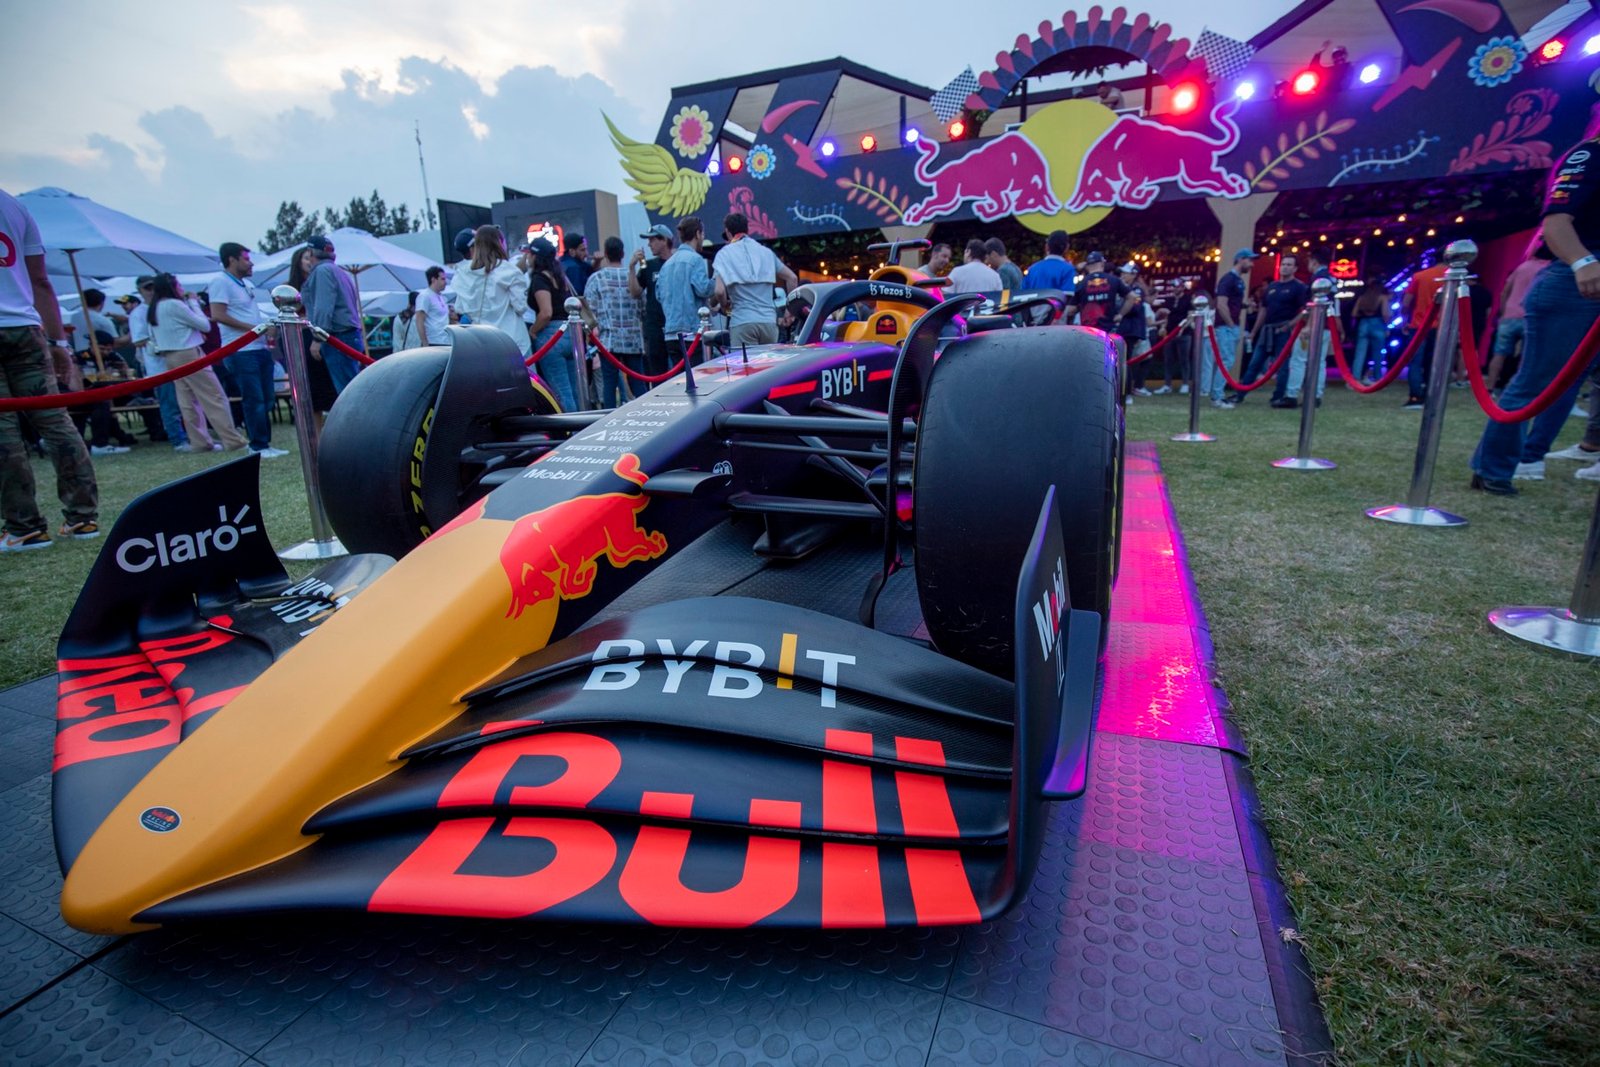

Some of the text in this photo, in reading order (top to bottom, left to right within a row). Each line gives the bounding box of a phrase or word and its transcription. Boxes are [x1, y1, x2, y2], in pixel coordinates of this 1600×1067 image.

[880, 285, 904, 296] Tezos
[821, 358, 866, 400] BYBIT
[622, 419, 667, 427] Tezos
[546, 455, 616, 465] infinitum
[523, 468, 577, 481] Mobil
[116, 518, 243, 573] Claro
[582, 633, 857, 709] BYBIT
[366, 719, 984, 930] Bull
